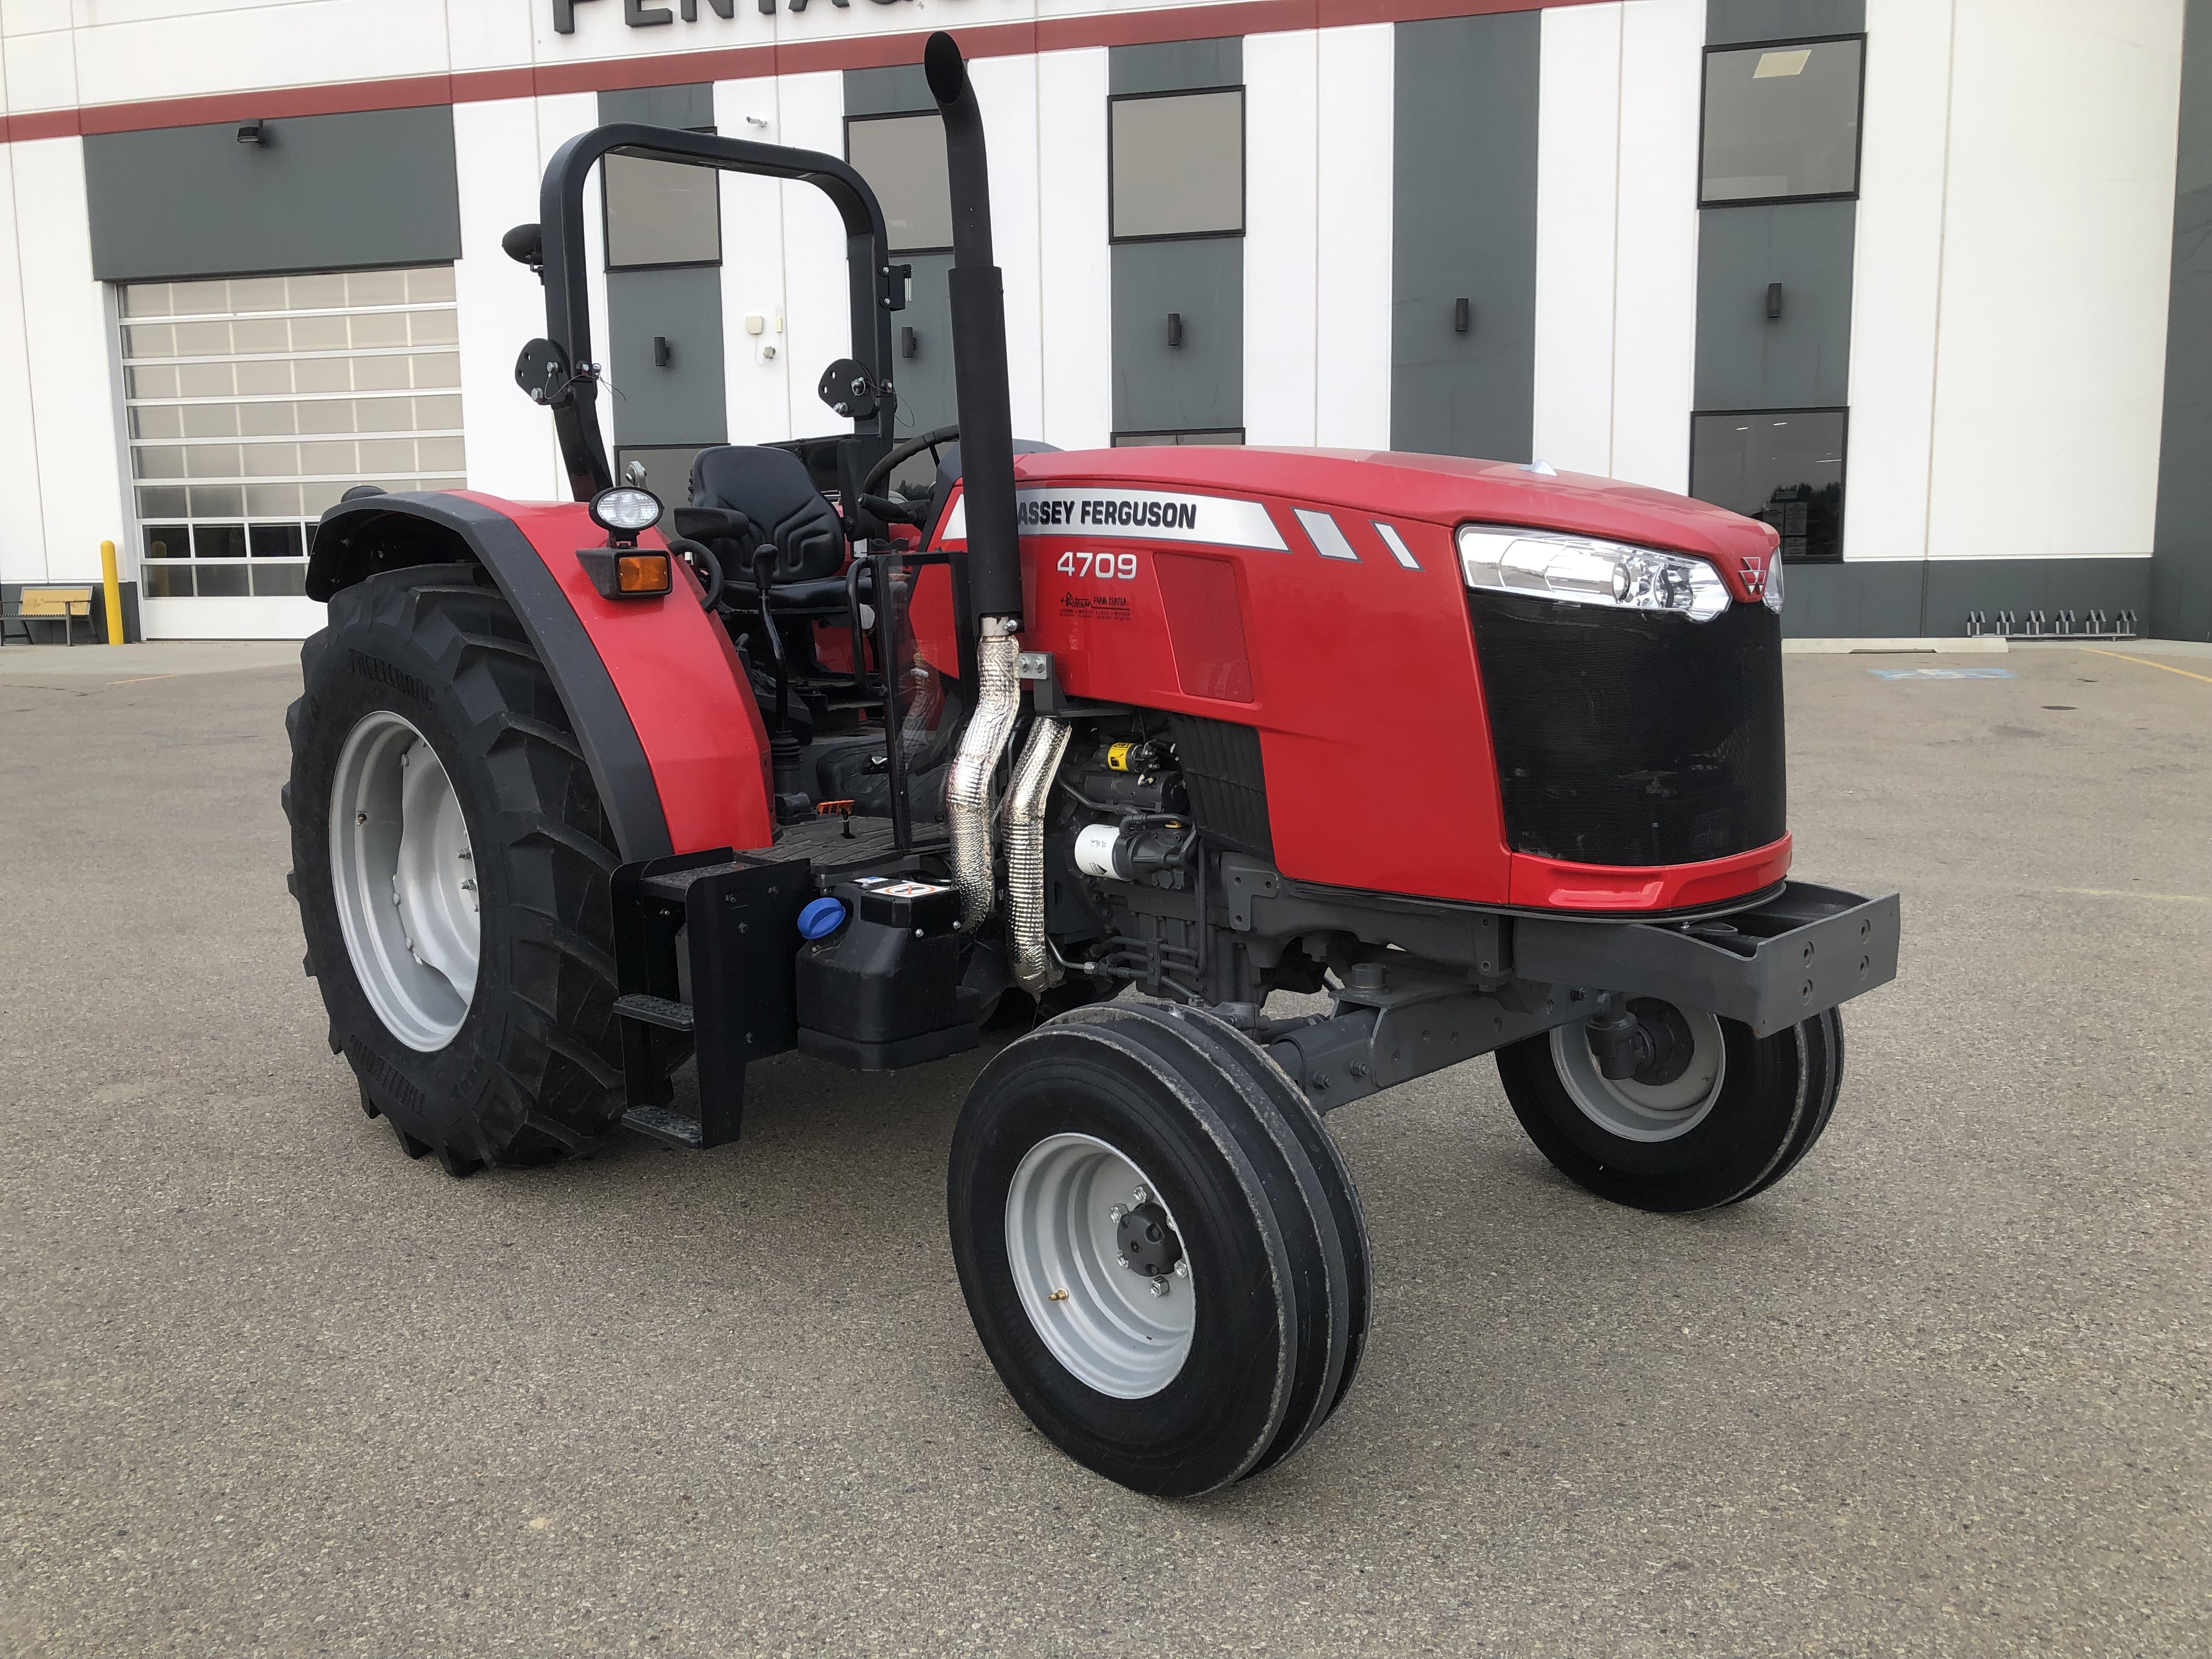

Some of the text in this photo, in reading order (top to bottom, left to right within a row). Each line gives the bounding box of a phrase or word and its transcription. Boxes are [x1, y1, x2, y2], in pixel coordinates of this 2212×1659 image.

[1018, 500, 1197, 529] ASSEY FERGUSON
[1057, 551, 1137, 580] 4709
[347, 647, 435, 711] TRELLEBORG
